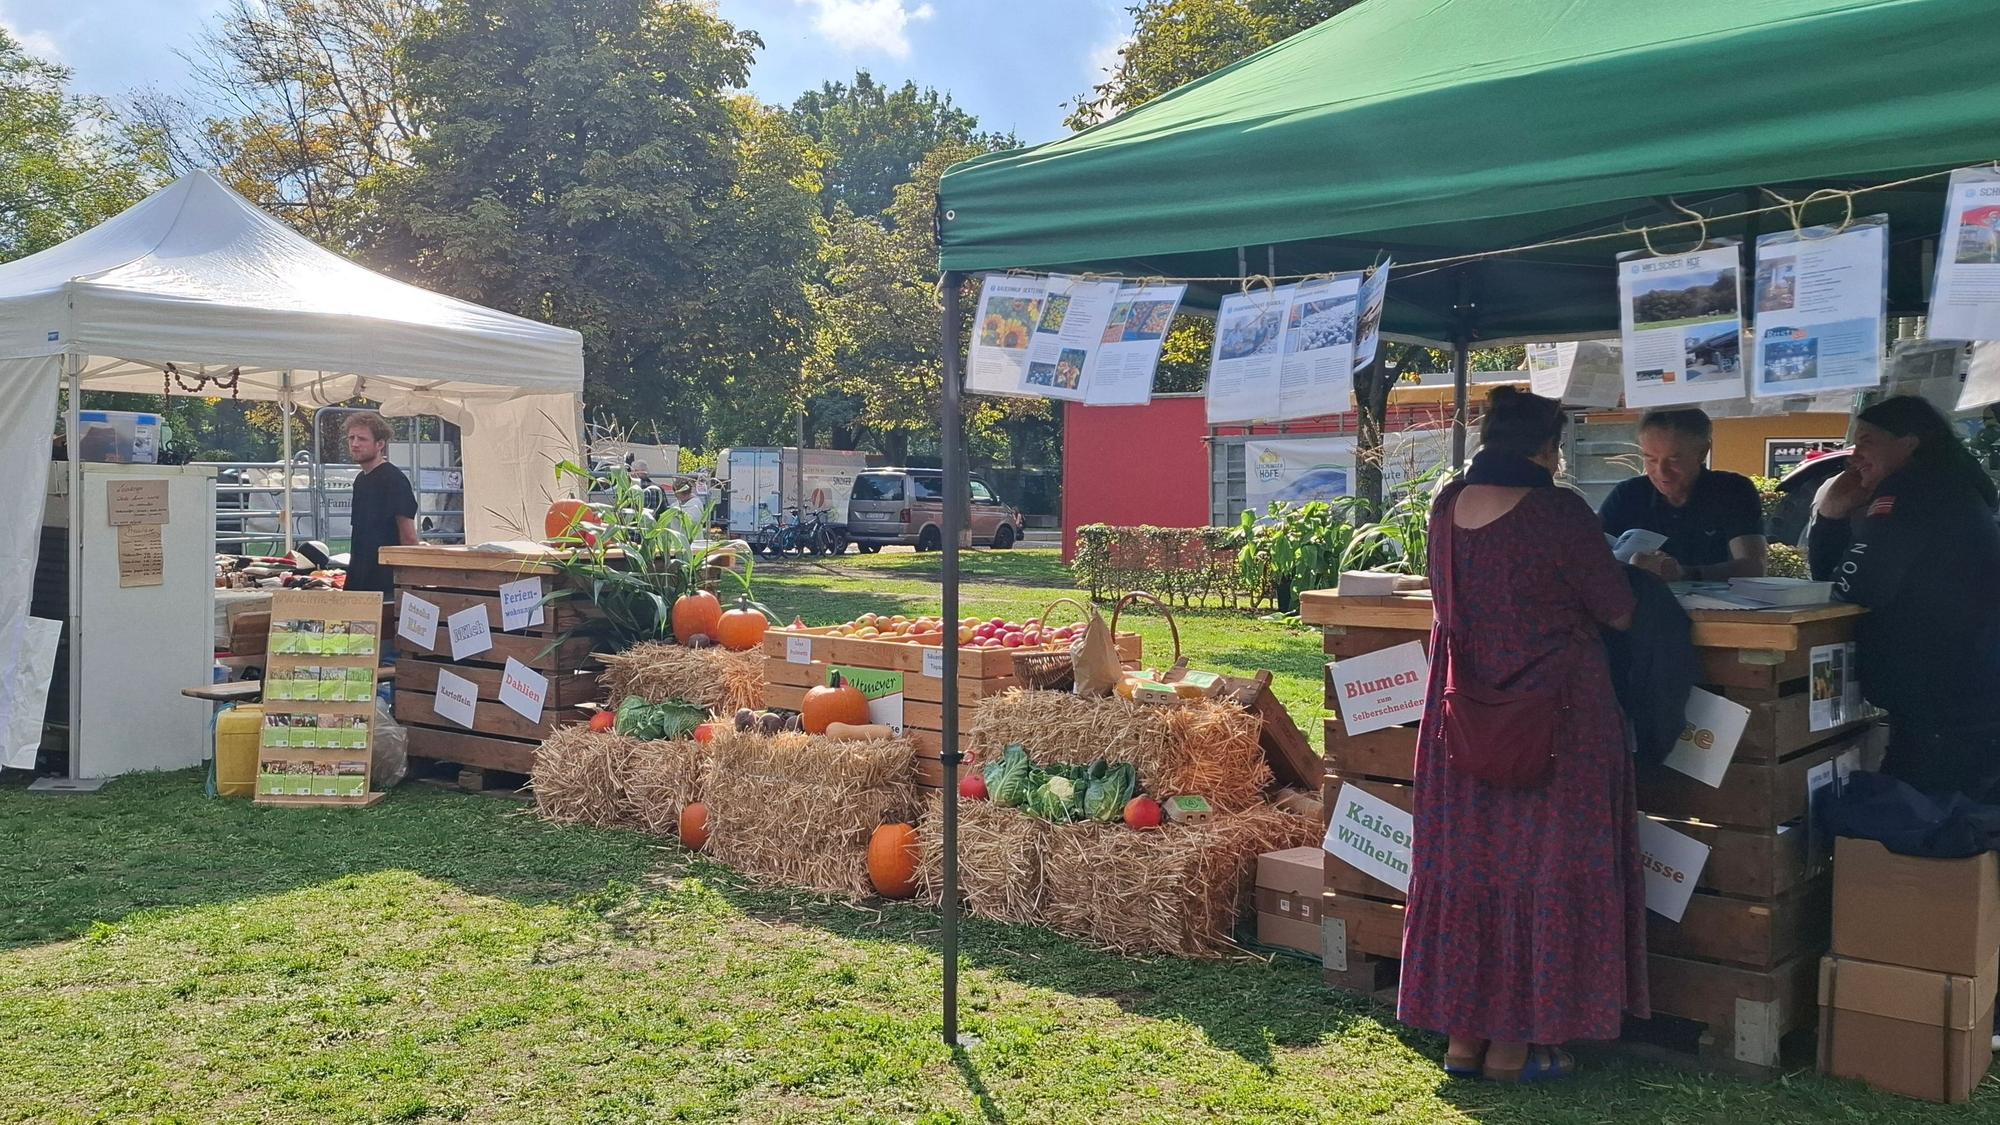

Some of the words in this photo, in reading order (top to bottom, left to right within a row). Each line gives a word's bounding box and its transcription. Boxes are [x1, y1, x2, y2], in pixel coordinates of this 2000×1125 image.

[328, 498, 351, 508] Fami
[1837, 543, 1868, 593] NOR
[504, 590, 538, 605] Ferien-
[453, 620, 486, 643] Milch
[440, 686, 471, 707] Kartoffeln
[505, 674, 540, 703] Dahlien
[1344, 670, 1419, 698] Blumen
[1352, 698, 1425, 722] Selberschneiden
[1377, 696, 1392, 704] zum
[1346, 800, 1412, 849] Kaiser
[1338, 824, 1409, 874] Wilhelm
[1640, 851, 1685, 884] üsse
